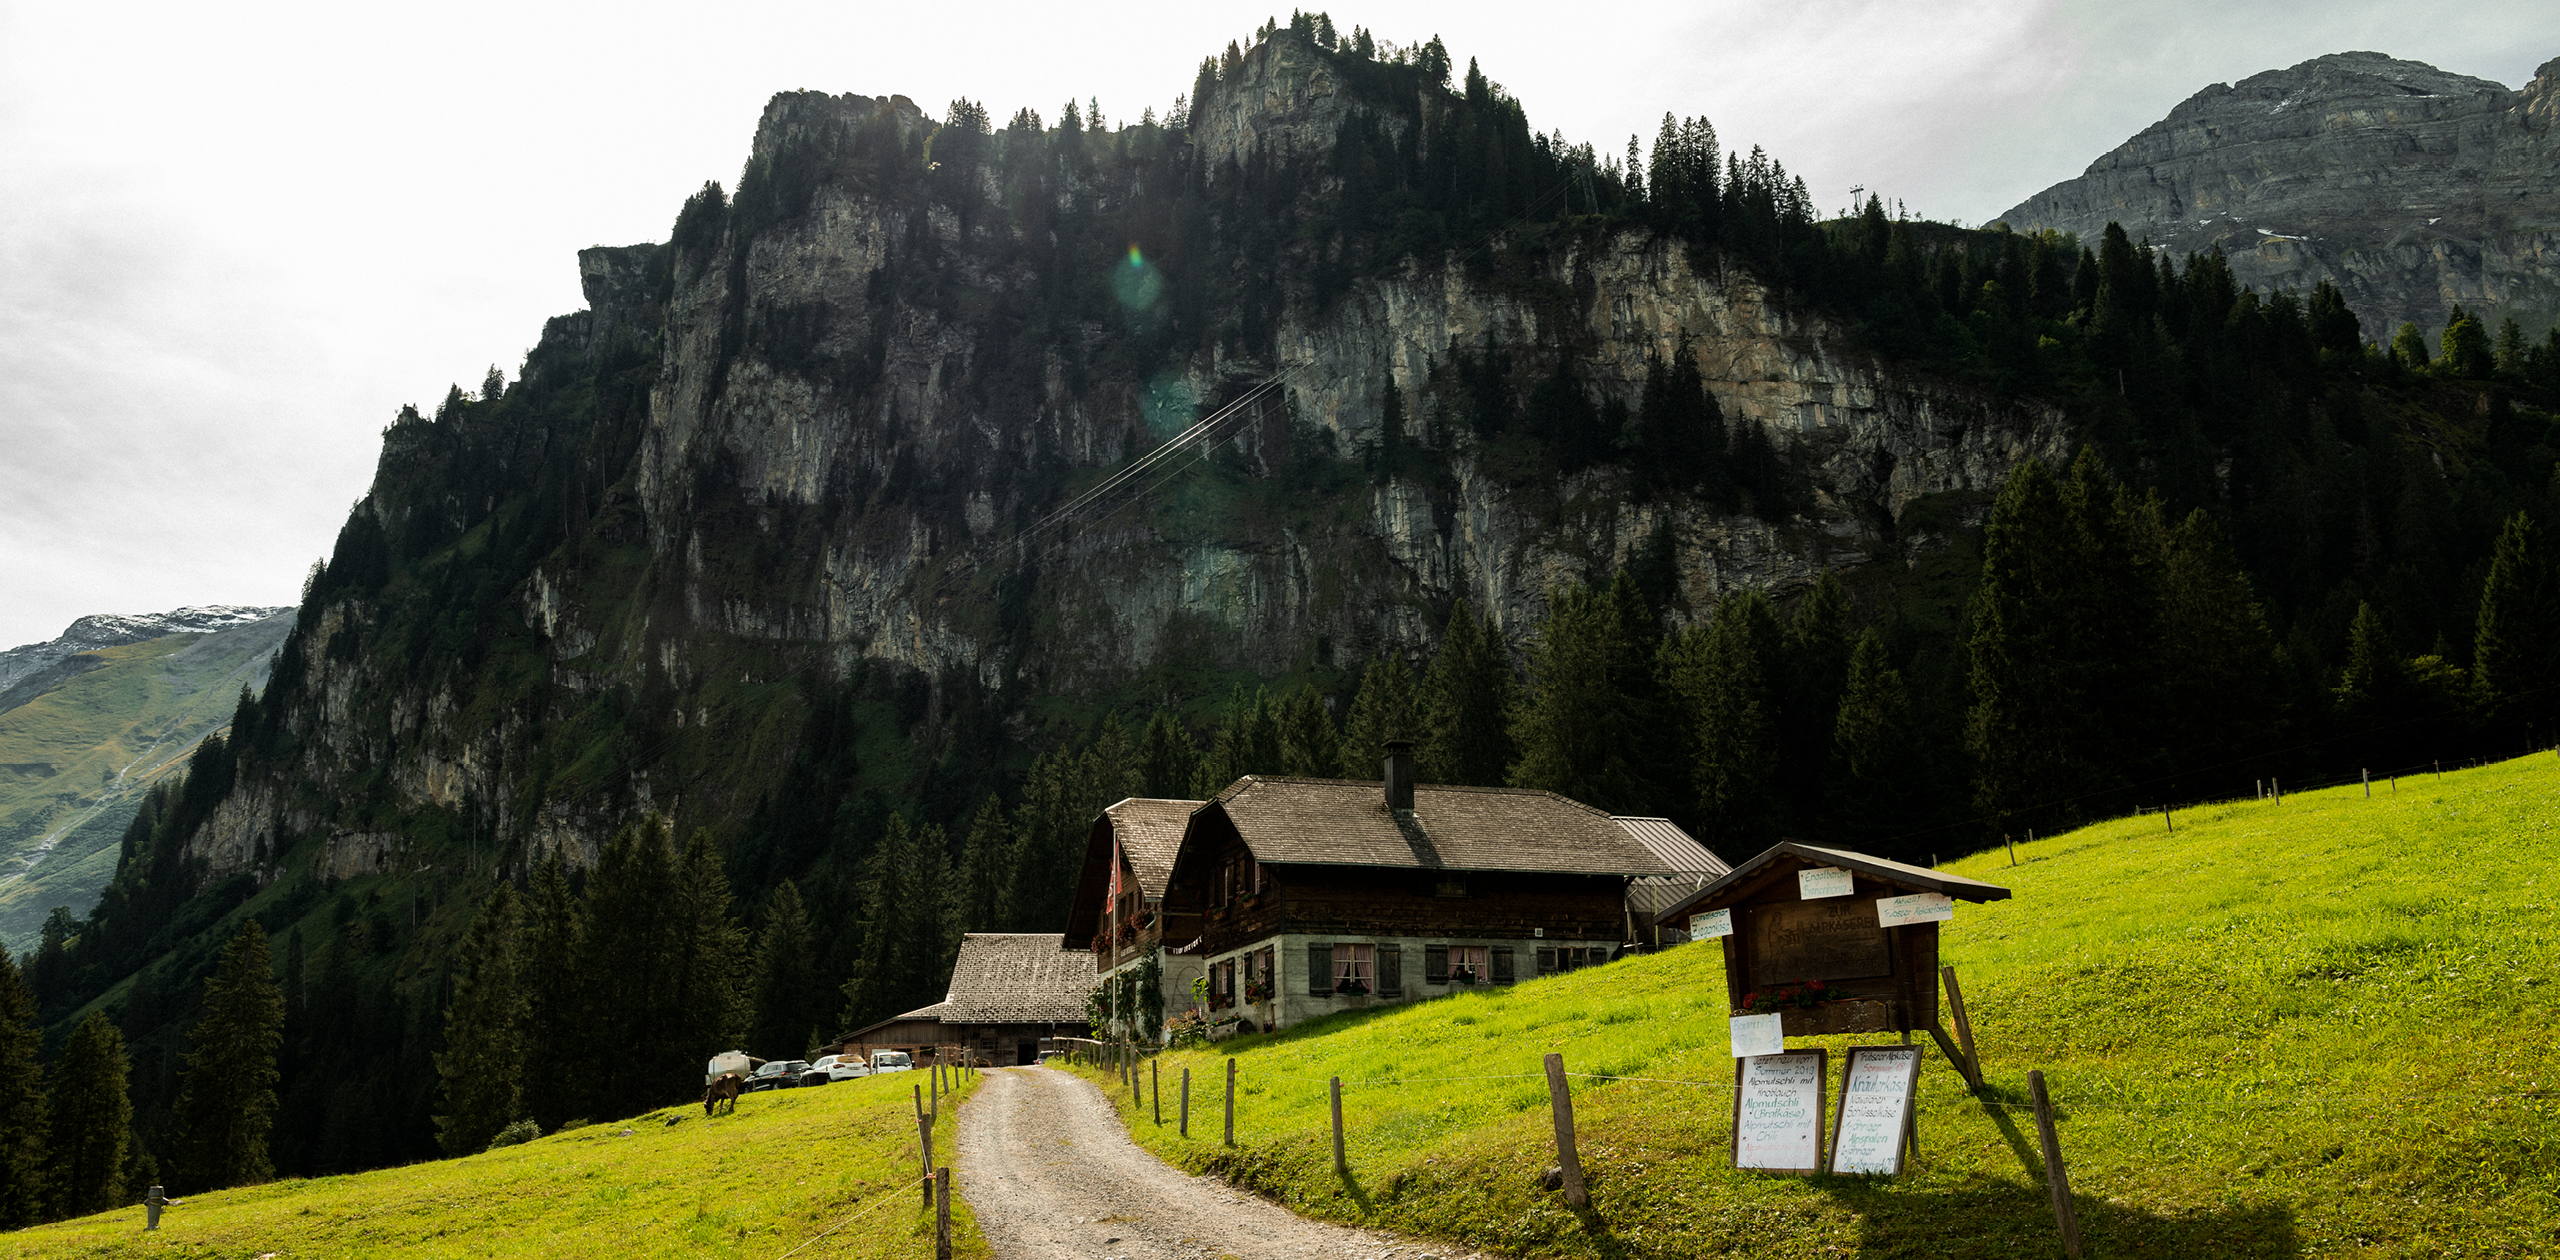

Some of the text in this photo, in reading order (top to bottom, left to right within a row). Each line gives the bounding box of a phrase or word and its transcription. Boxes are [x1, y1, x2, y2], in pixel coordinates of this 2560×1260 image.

[1826, 905, 1851, 918] ZUR
[1776, 1056, 1793, 1065] neu
[1796, 1056, 1813, 1064] vom
[1755, 1065, 1815, 1075] Sommer 2019
[1862, 1063, 1893, 1073] Sommer
[1748, 1076, 1815, 1089] Alpmutschli mit
[1852, 1075, 1907, 1093] Kräuterkäse
[1757, 1088, 1797, 1097] Knoblauch
[1744, 1097, 1800, 1112] Alpmutschli
[1753, 1108, 1805, 1119] (Bratkäse)
[1744, 1119, 1812, 1132] Alpmutschli mit
[1756, 1131, 1779, 1141] Chili
